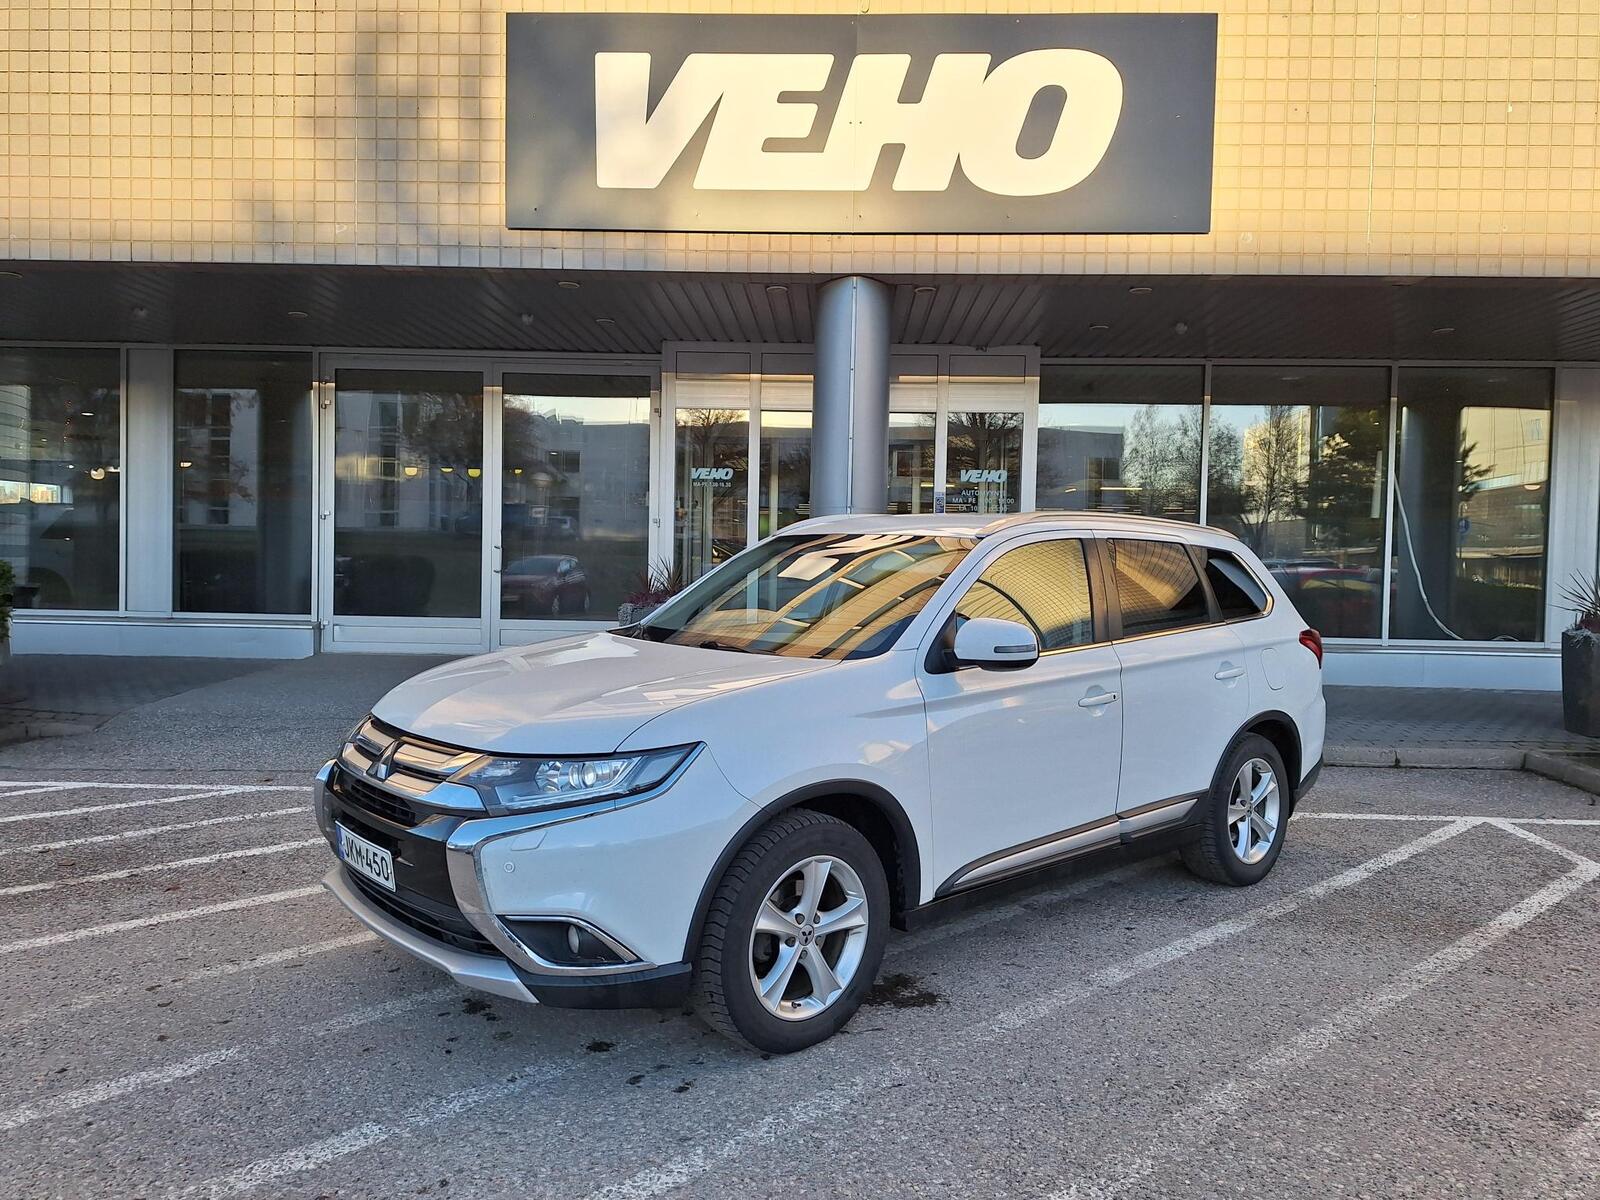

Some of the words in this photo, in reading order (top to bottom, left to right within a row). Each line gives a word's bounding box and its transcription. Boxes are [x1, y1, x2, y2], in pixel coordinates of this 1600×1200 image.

[595, 48, 1124, 197] VEHO
[691, 467, 734, 480] VEHO
[960, 469, 1008, 483] VEHO
[344, 835, 390, 882] JKM-450
